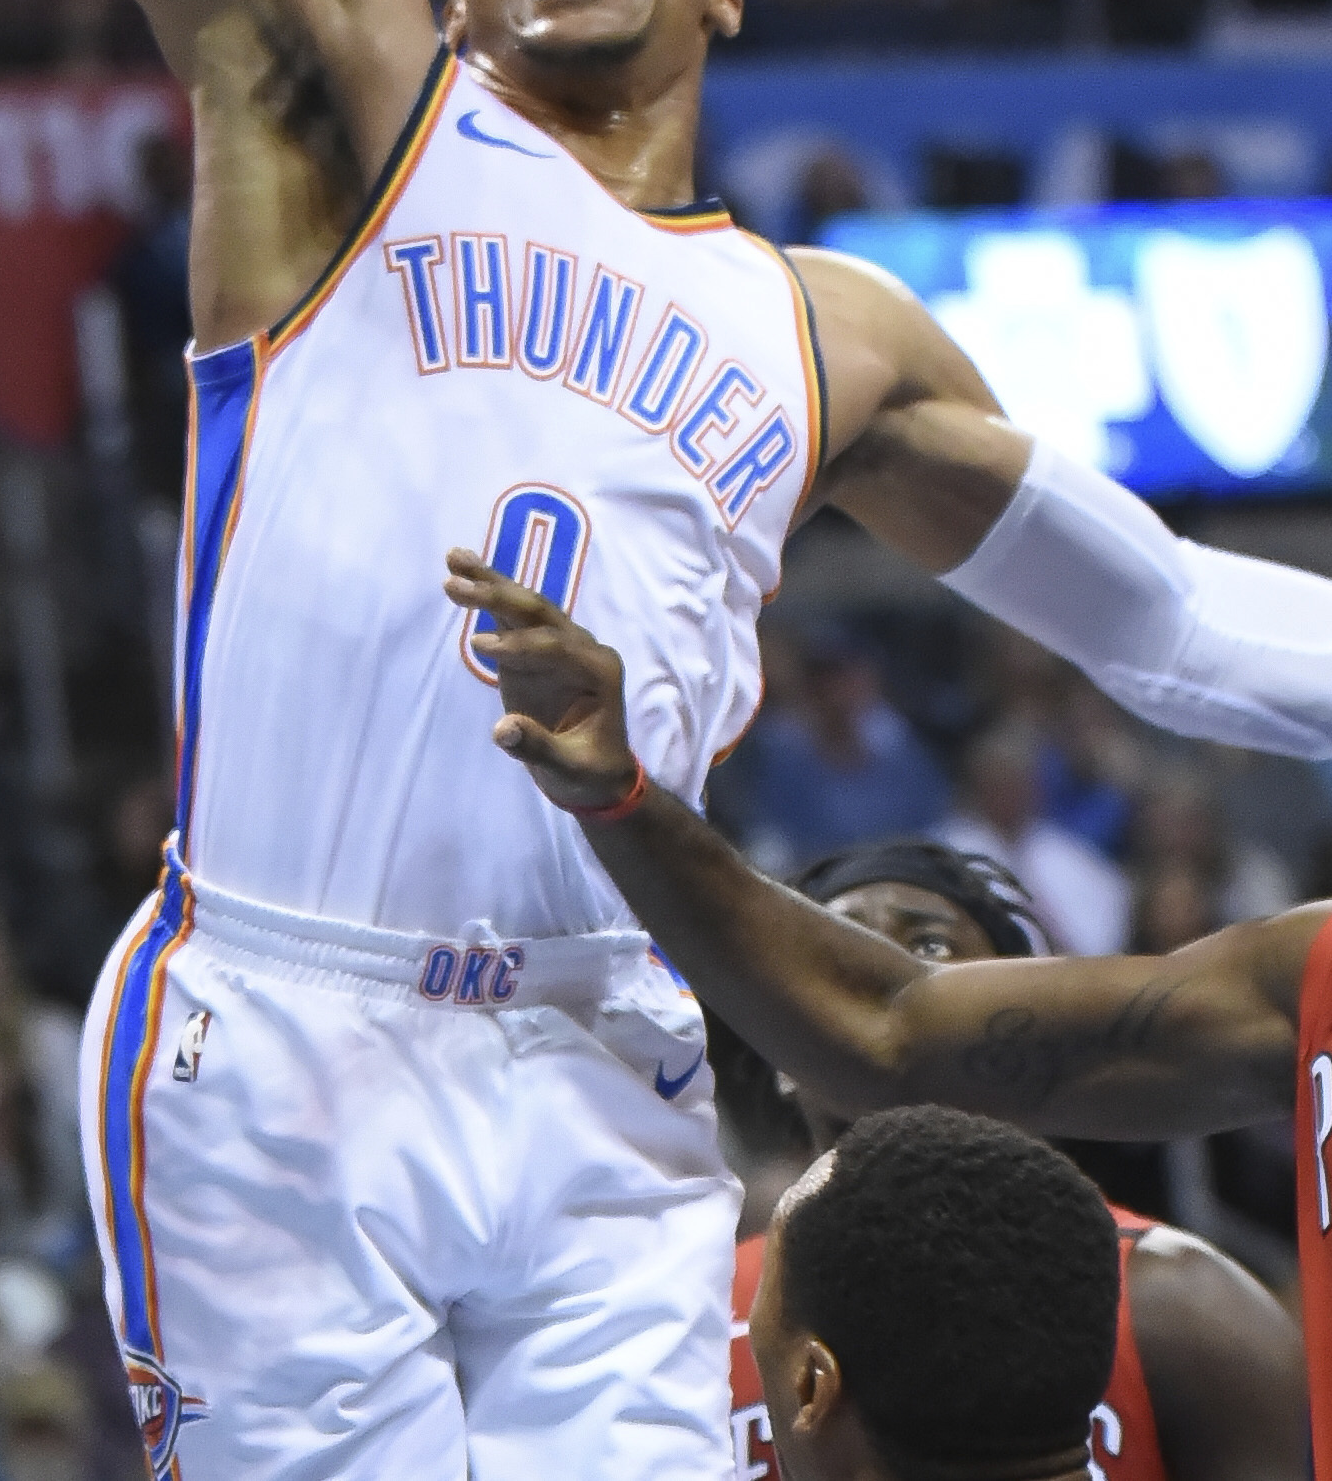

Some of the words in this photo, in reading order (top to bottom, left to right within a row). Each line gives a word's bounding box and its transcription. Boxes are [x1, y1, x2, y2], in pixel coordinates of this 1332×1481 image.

[384, 231, 796, 532] THUNDER
[459, 481, 591, 686] 0
[419, 944, 525, 1005] OKC
